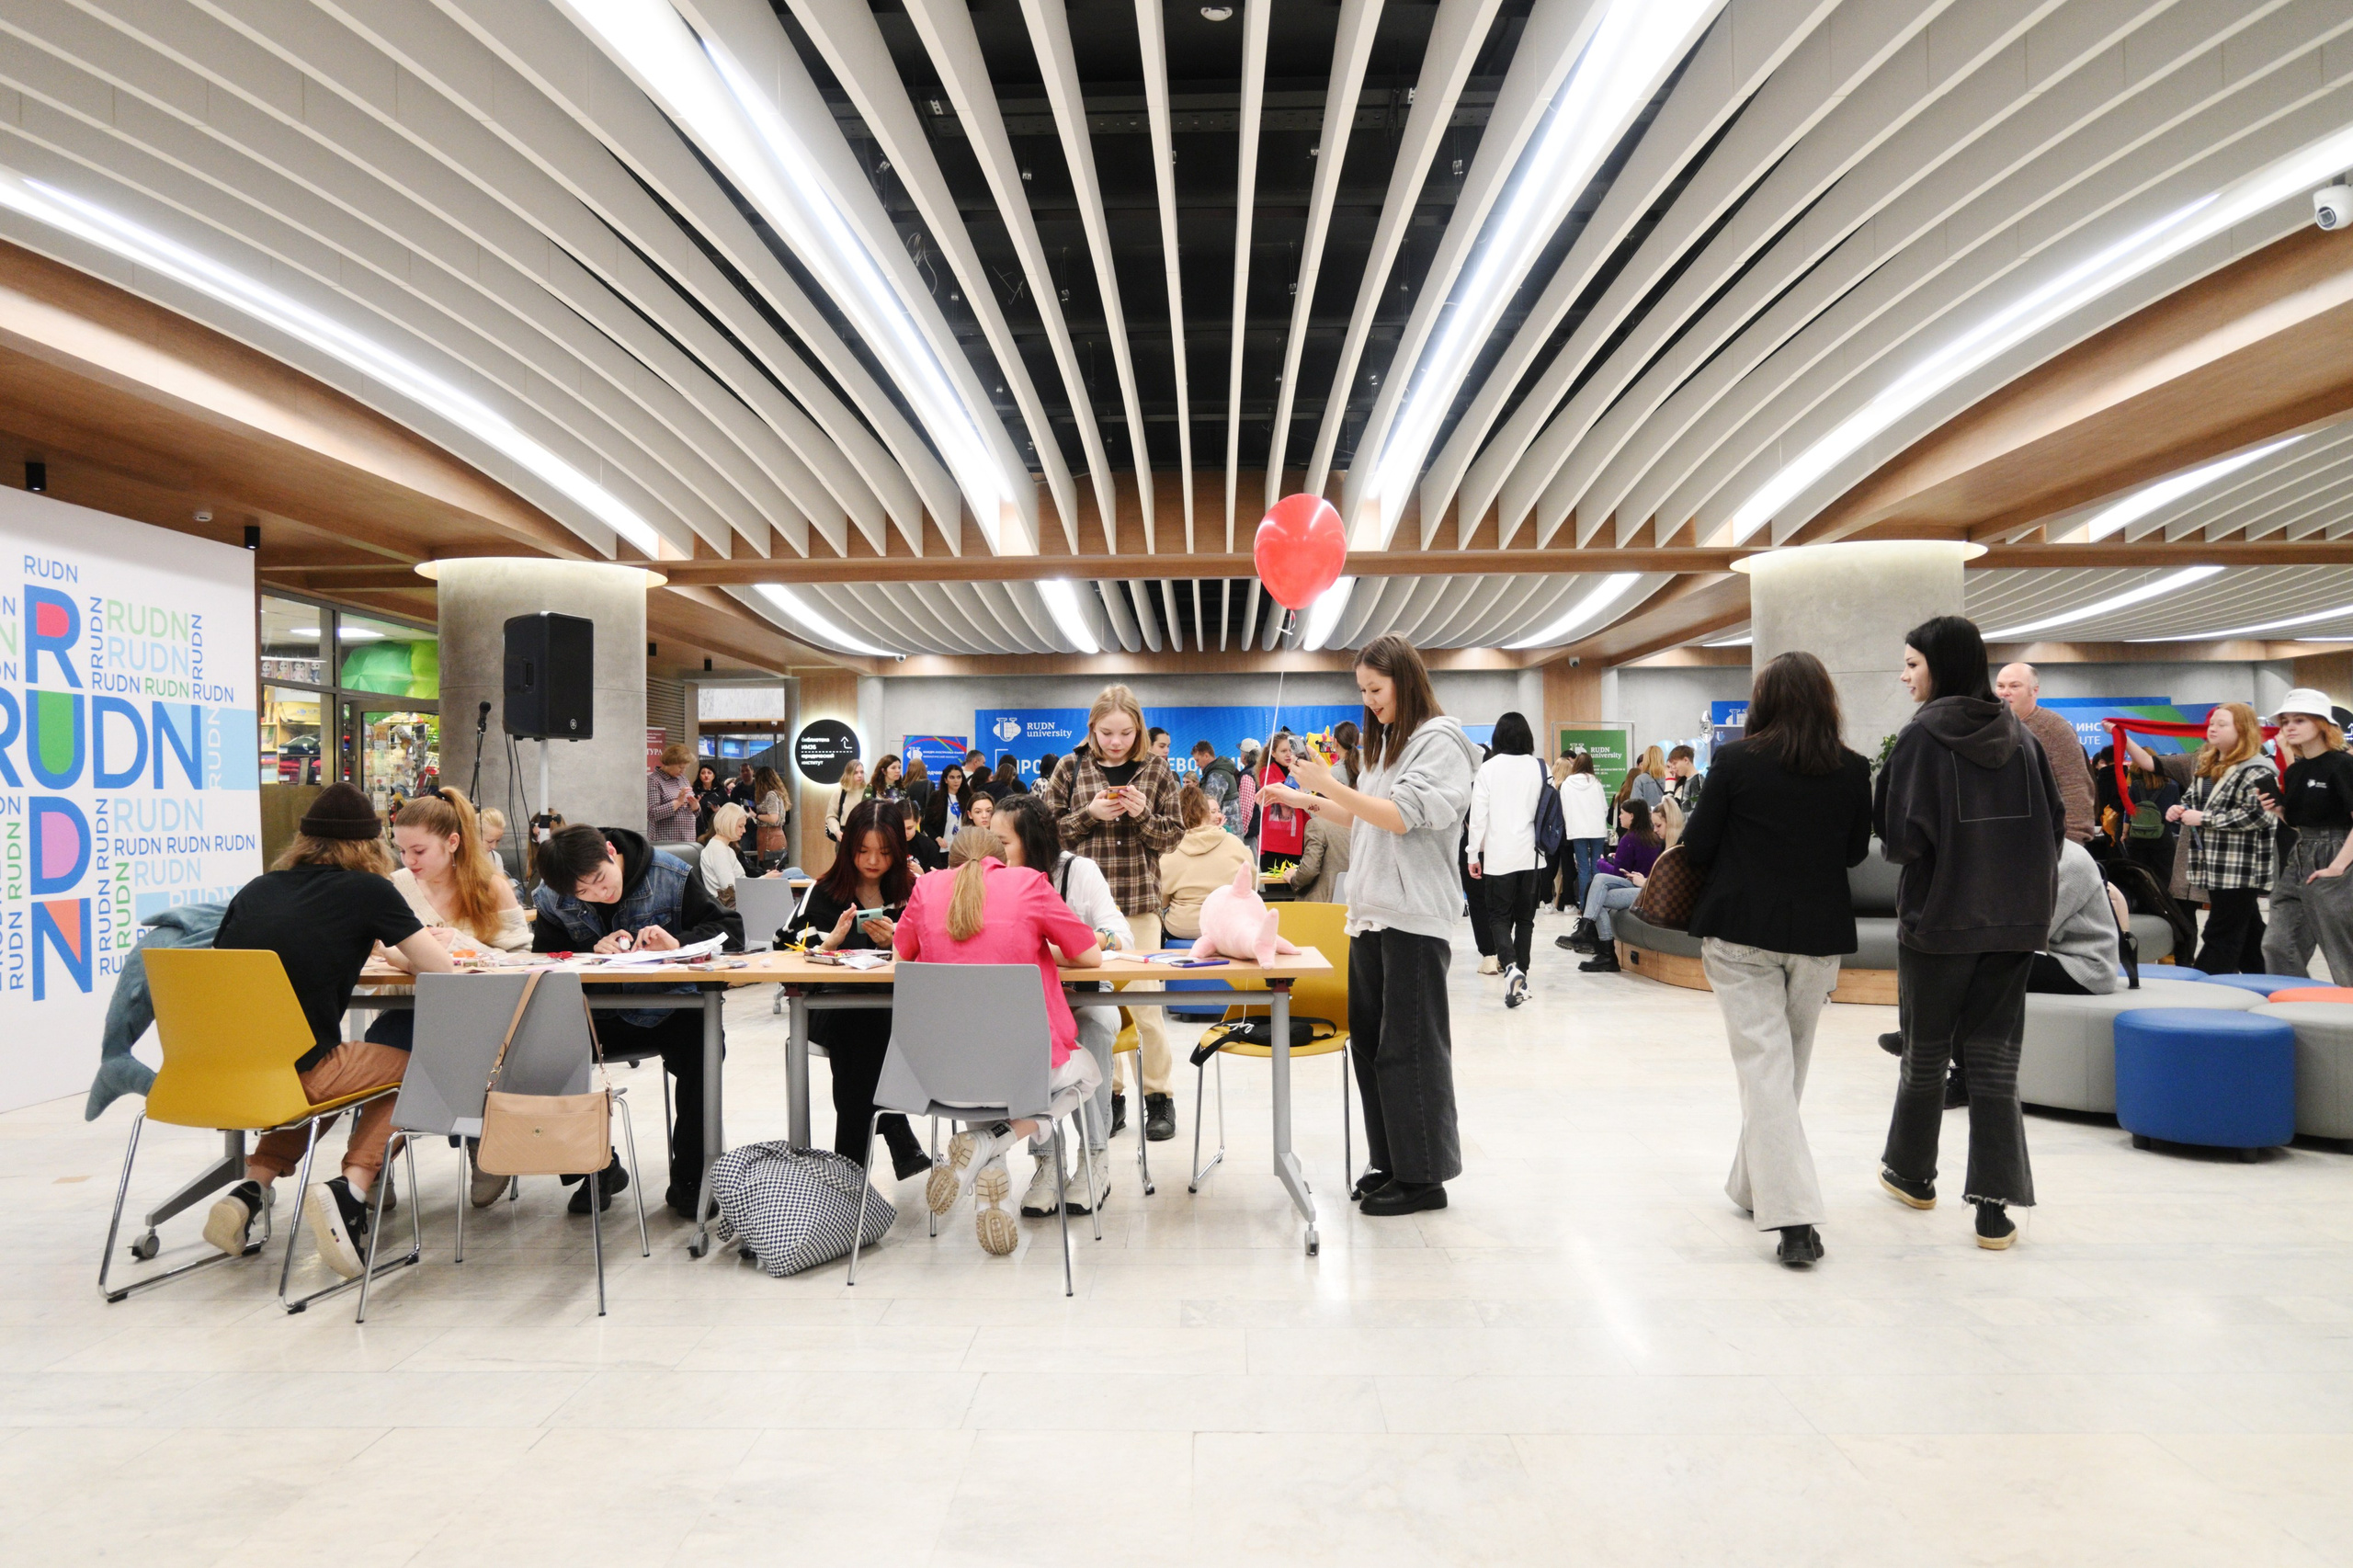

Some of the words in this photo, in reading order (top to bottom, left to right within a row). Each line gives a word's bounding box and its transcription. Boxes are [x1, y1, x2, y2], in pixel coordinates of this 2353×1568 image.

[24, 554, 78, 584] RUDN
[90, 597, 103, 669] RUDN
[107, 599, 188, 642] RUDN
[108, 636, 189, 676] RUDN
[191, 614, 203, 680] RUDN
[92, 672, 141, 694] RUDN
[145, 677, 189, 699] RUDN
[192, 683, 234, 703] RUDN
[1027, 722, 1055, 730] RUDN
[1027, 729, 1073, 739] university
[207, 705, 222, 790] RUDN
[96, 799, 109, 870] RUDN
[113, 798, 204, 833] RUDN
[6, 822, 23, 901] RUDN
[114, 837, 162, 857] RUDN
[166, 835, 210, 855] RUDN
[214, 835, 256, 851] RUDN
[134, 858, 201, 887] RUDN
[98, 879, 111, 951] RUDN
[115, 862, 131, 949] RUDN
[8, 911, 24, 990] RUDN
[99, 955, 127, 976] RU
